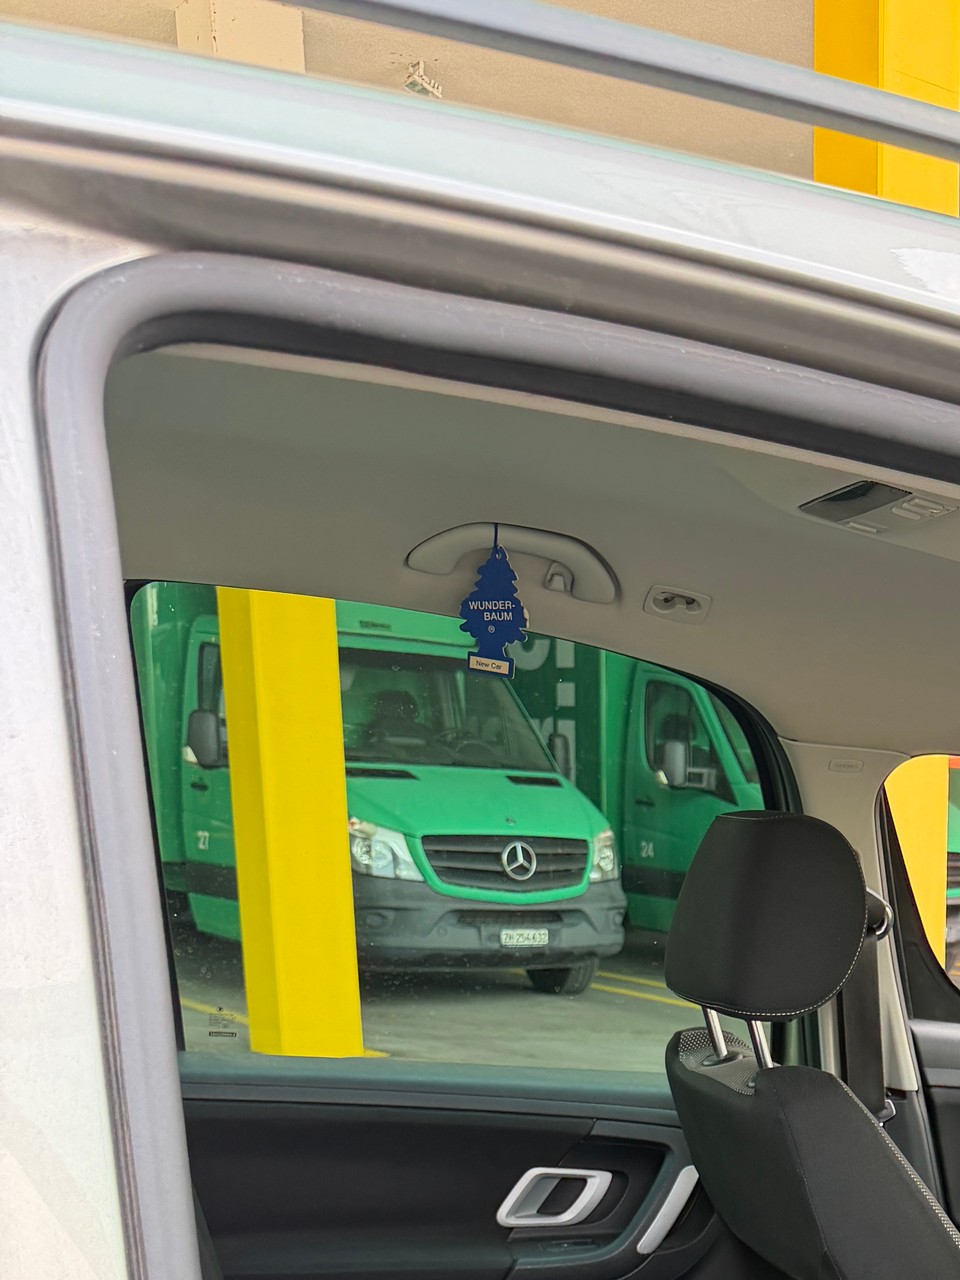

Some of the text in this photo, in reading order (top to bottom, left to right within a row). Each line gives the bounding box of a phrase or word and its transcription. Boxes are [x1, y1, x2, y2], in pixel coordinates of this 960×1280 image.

[469, 601, 515, 610] WUNDER-
[484, 612, 513, 621] BAUM
[476, 660, 490, 668] New
